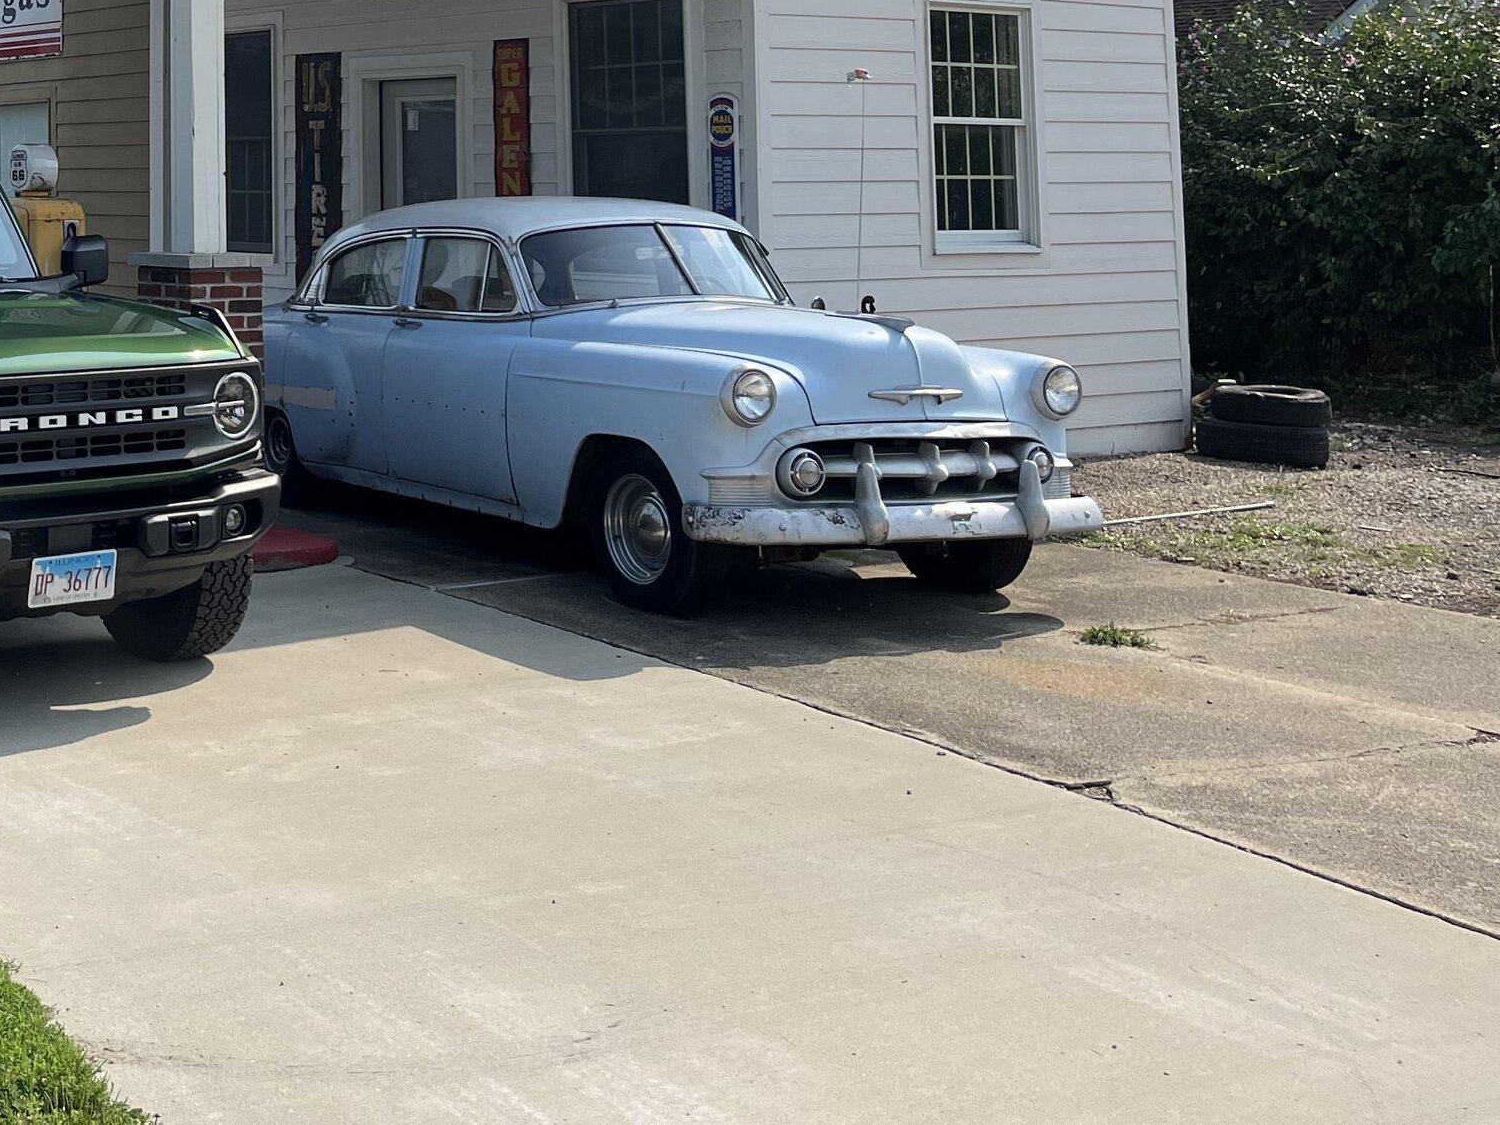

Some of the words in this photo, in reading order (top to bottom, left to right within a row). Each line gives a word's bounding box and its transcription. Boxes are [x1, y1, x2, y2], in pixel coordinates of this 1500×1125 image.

[496, 47, 525, 60] SUPER
[11, 169, 25, 182] 66
[308, 120, 328, 257] TIRE
[35, 572, 54, 596] DP
[63, 565, 112, 593] 36777
